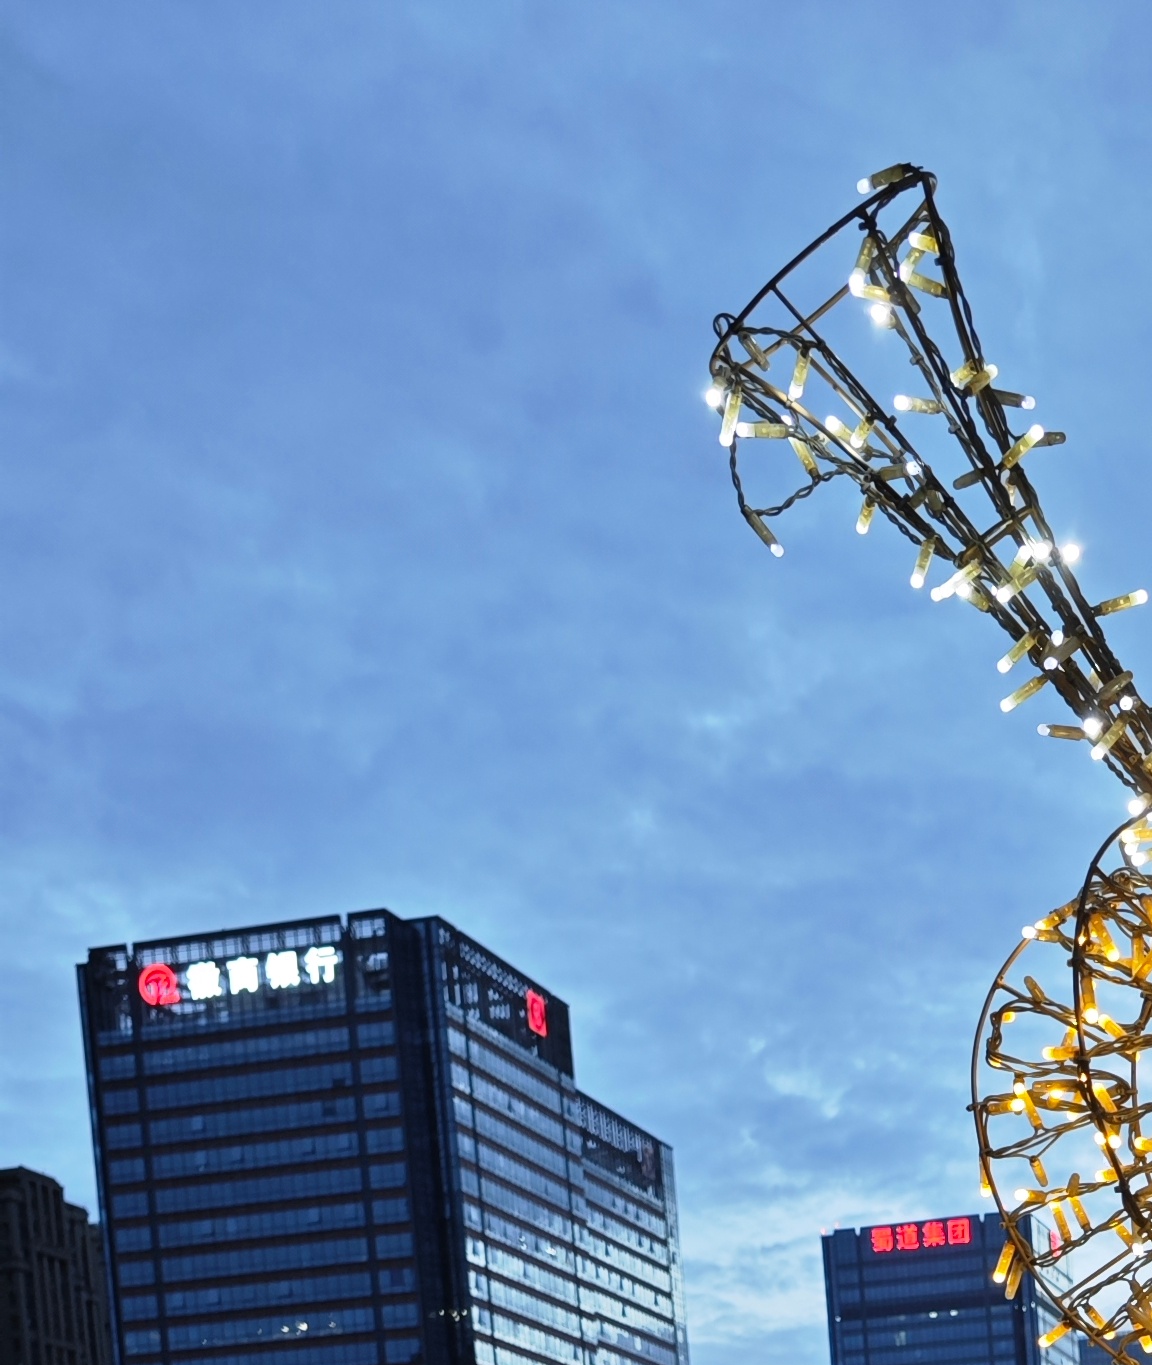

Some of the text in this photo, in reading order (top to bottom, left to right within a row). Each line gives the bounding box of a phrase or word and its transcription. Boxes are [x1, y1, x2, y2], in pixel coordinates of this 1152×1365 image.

[186, 946, 339, 1000] 徽商银行
[871, 1217, 970, 1252] 蜀道集团
